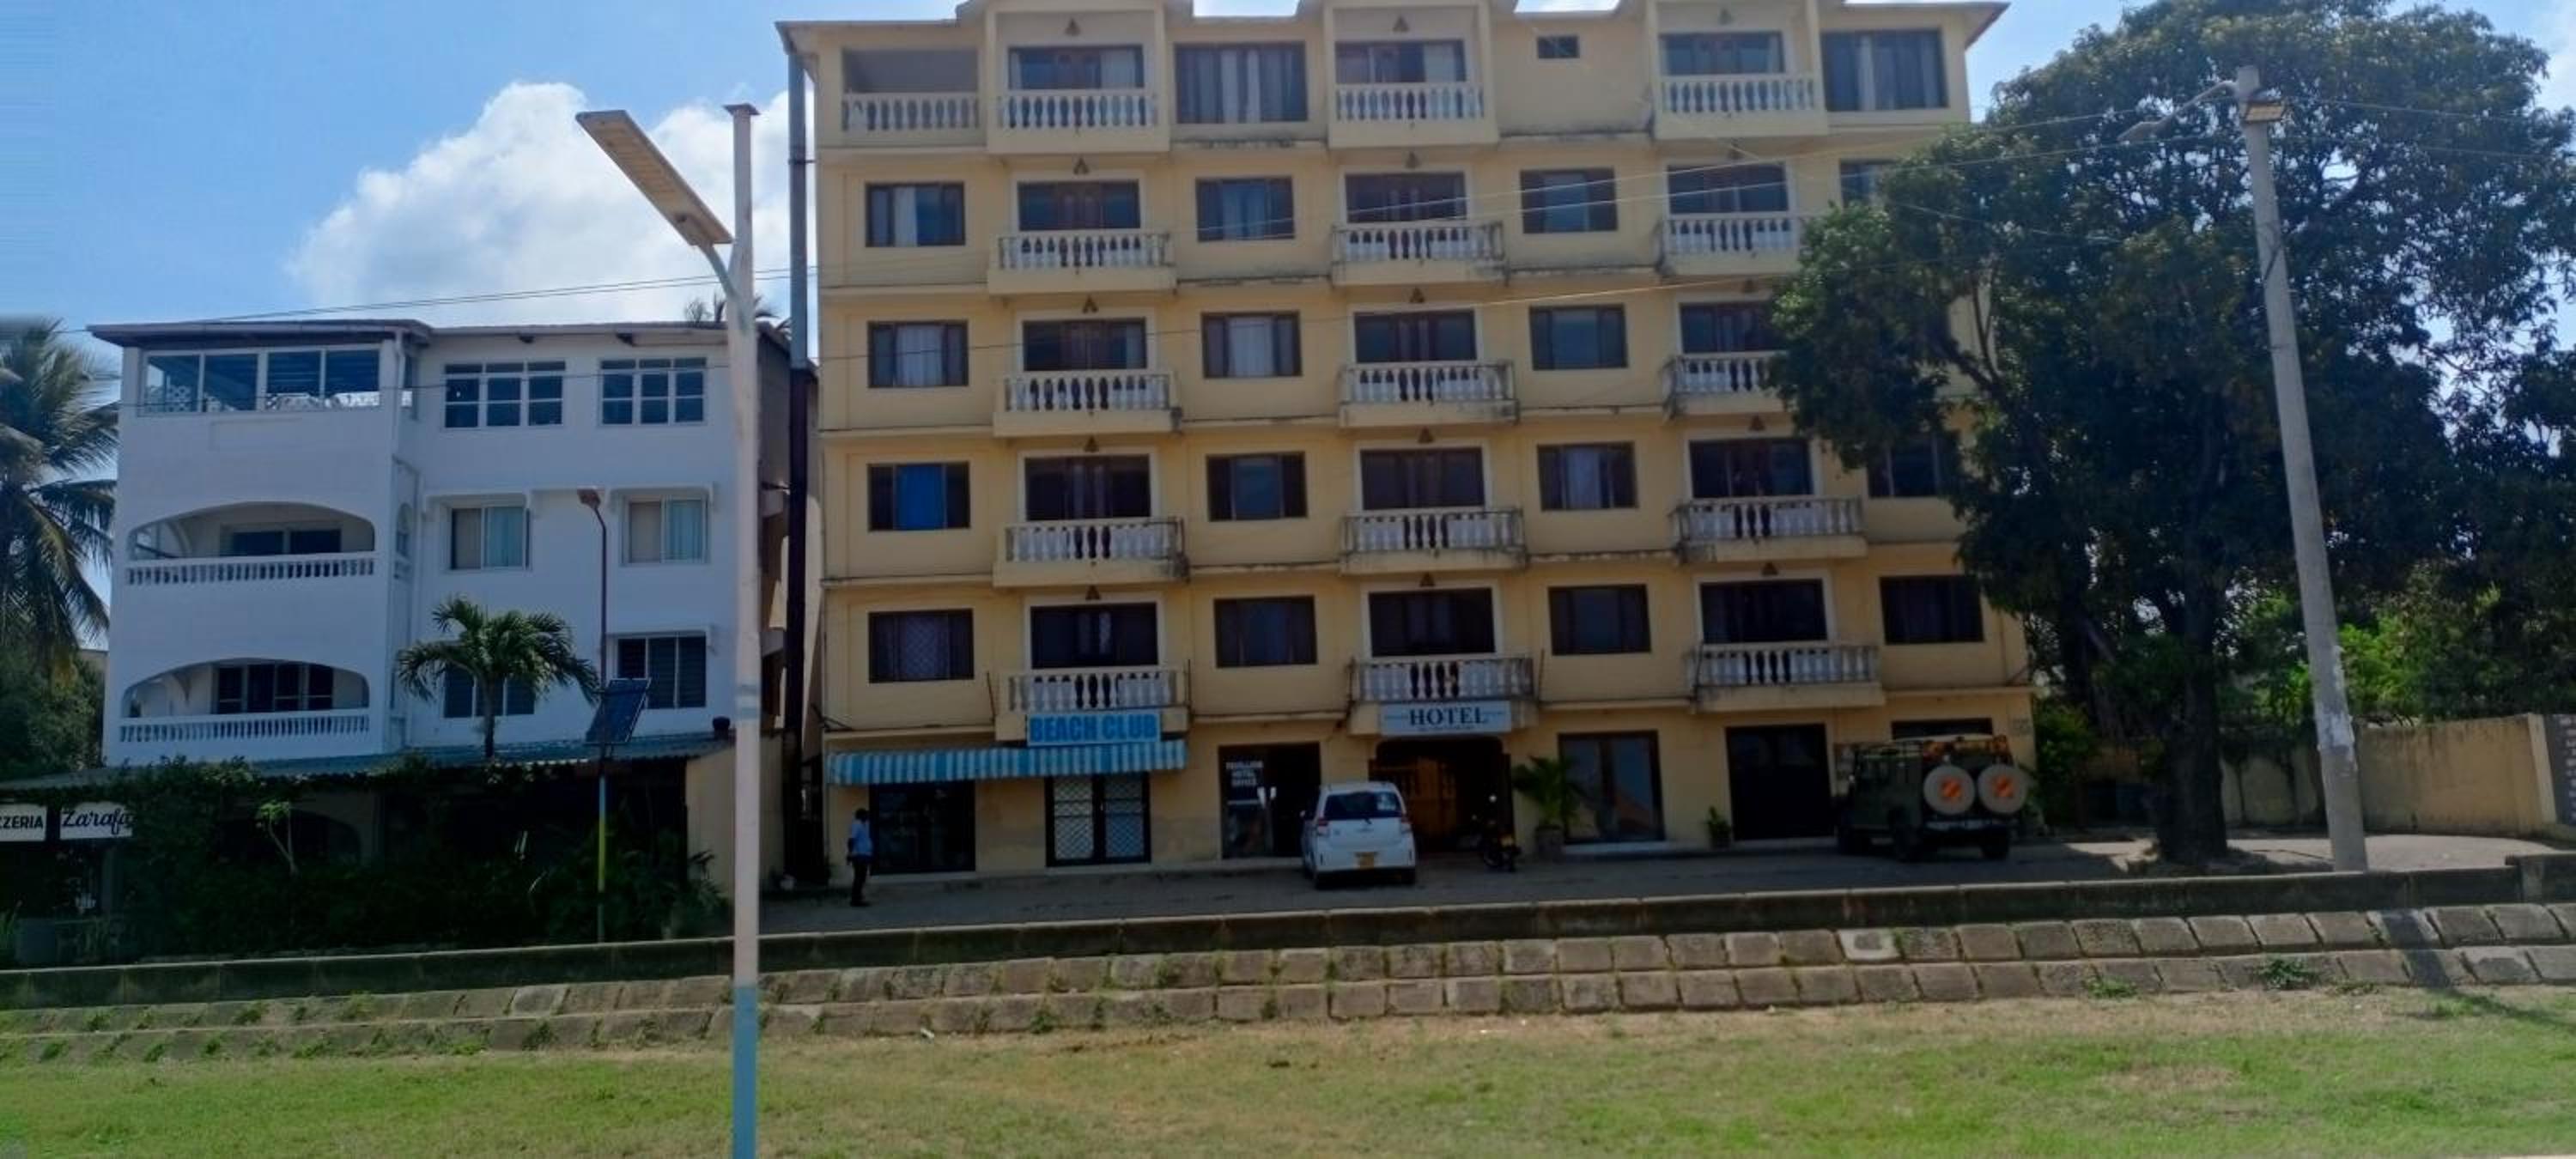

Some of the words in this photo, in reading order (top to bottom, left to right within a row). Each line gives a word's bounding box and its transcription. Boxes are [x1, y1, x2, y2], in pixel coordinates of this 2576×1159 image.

[1030, 716, 1096, 742] BEACH
[1102, 713, 1157, 740] CLUB
[1410, 707, 1487, 725] HOTEL
